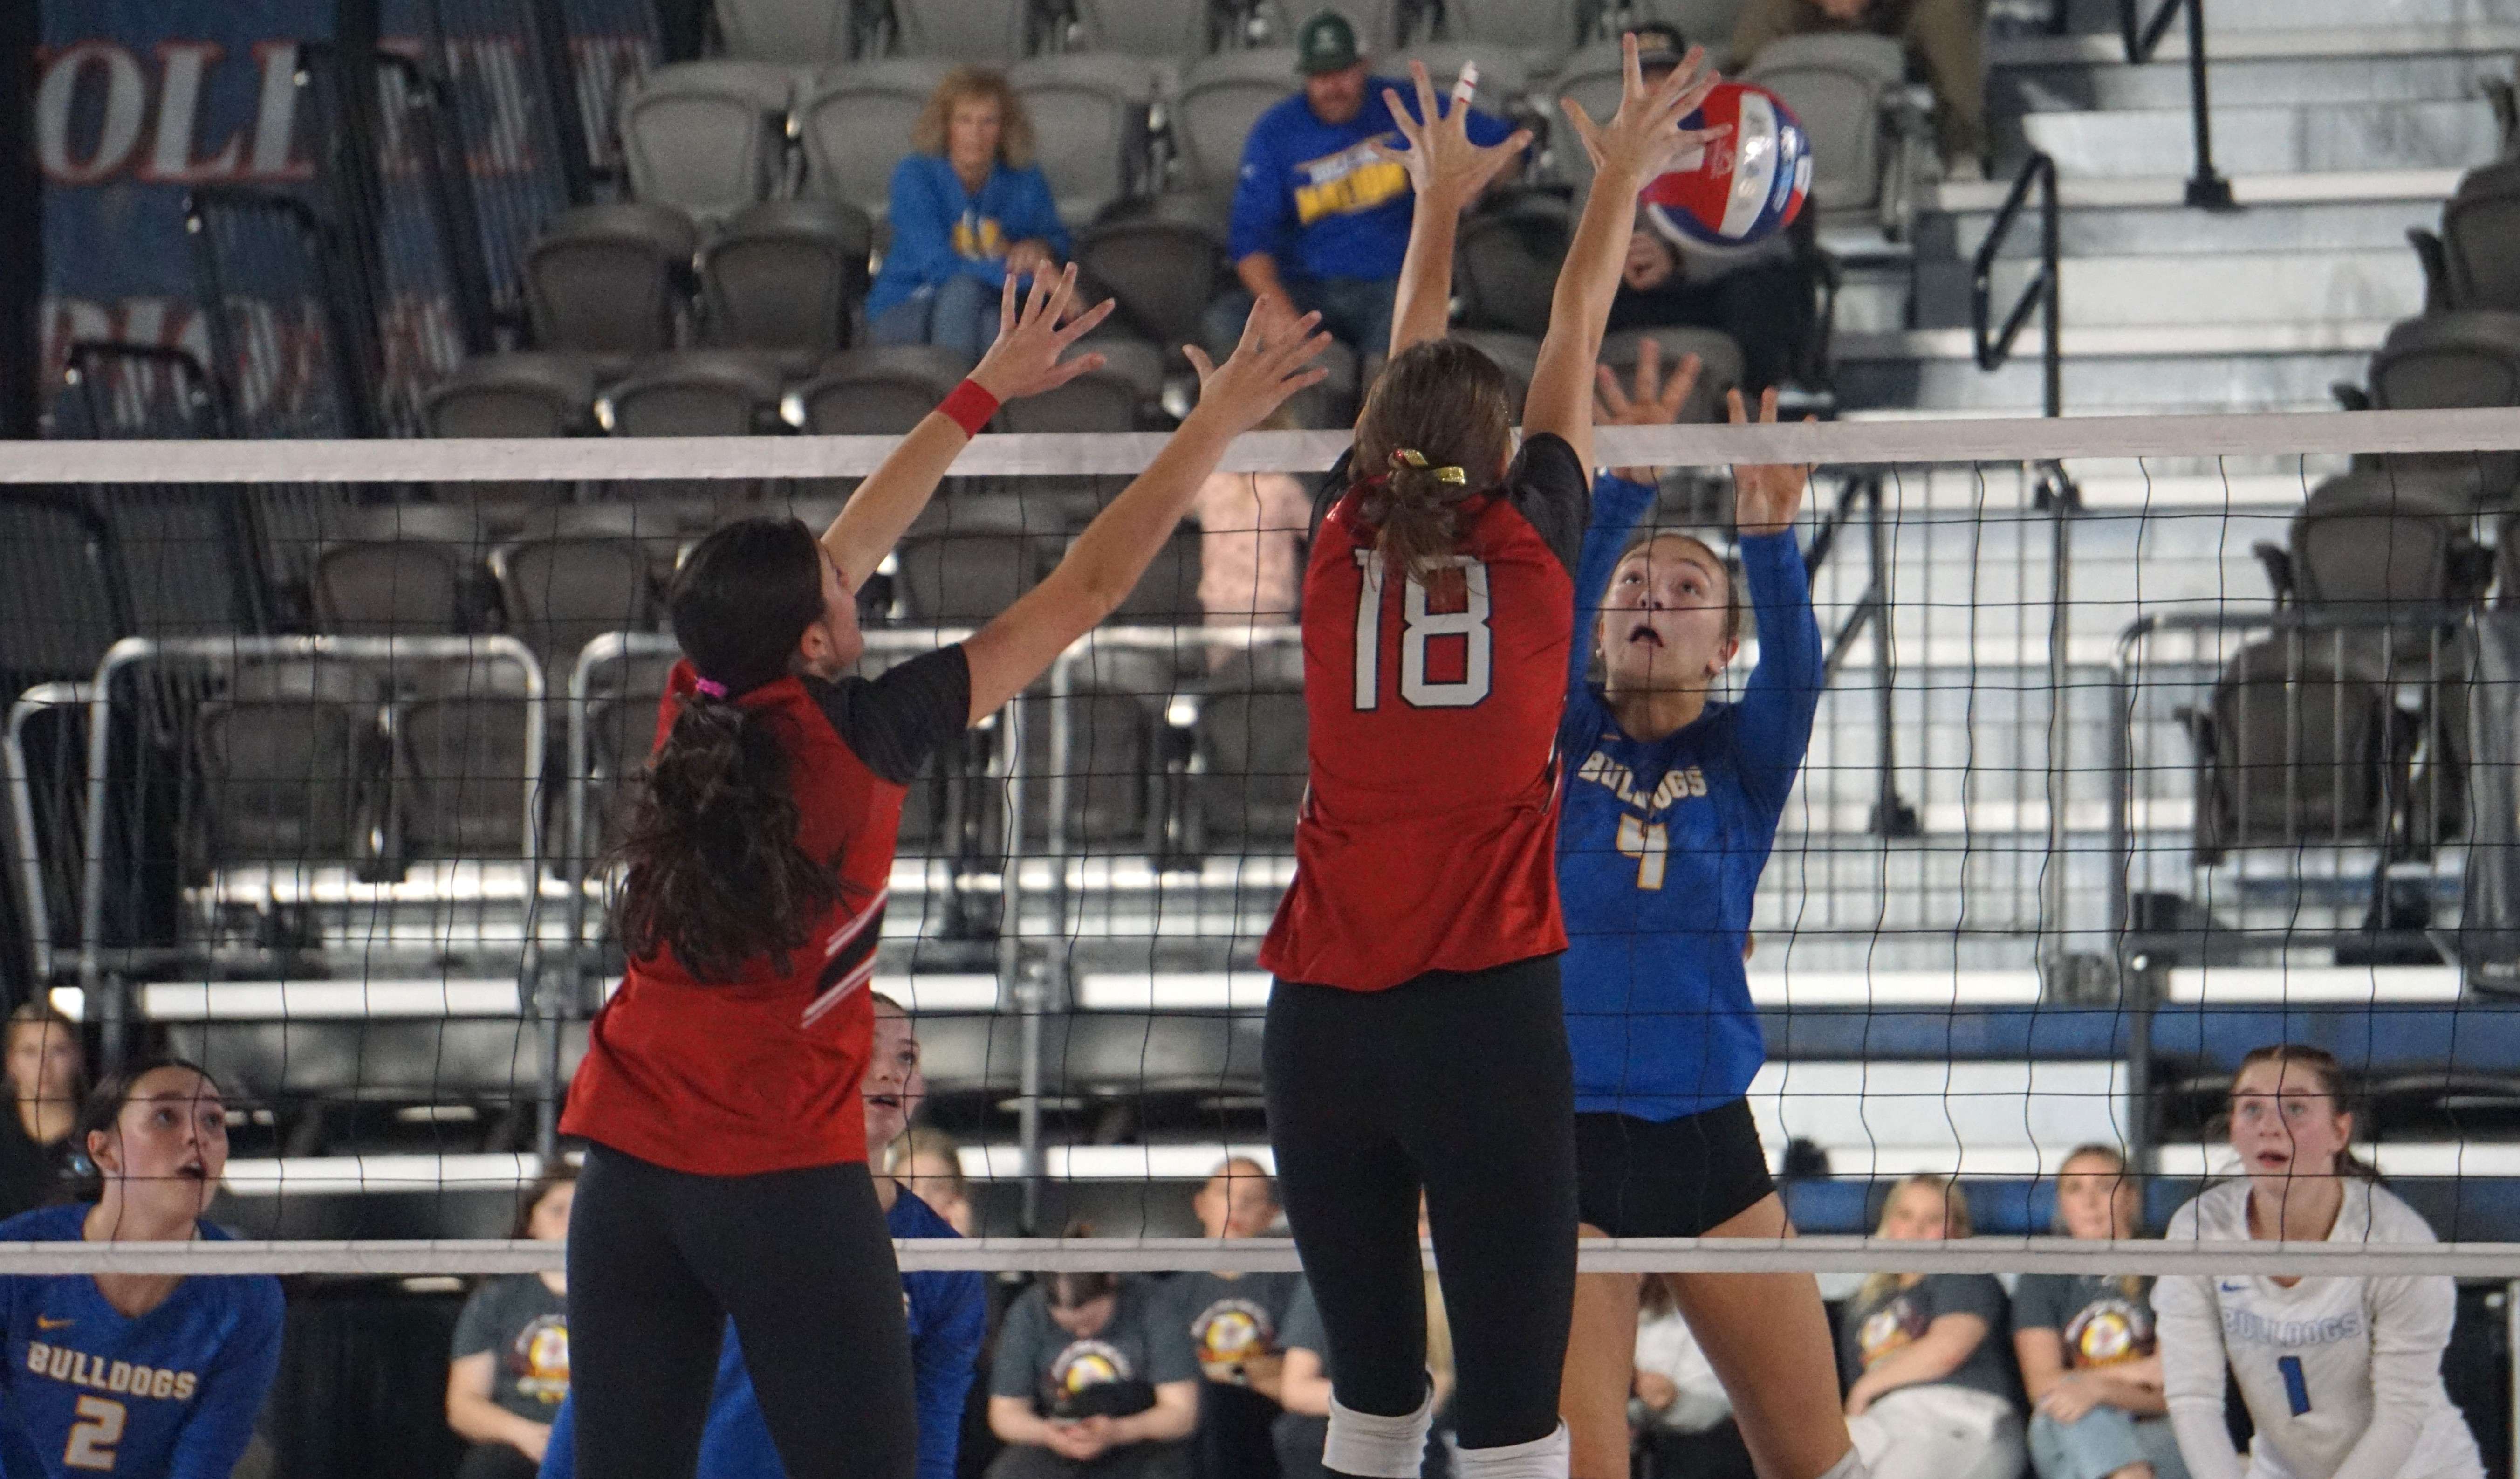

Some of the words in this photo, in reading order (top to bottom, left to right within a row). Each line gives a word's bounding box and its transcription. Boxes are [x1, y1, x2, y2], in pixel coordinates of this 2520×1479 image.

[1352, 547, 1493, 712] 18
[1616, 812, 1669, 891] 4
[27, 1341, 198, 1402] BULLDOGS
[2277, 1355, 2313, 1417] 1
[63, 1394, 127, 1472] 2
